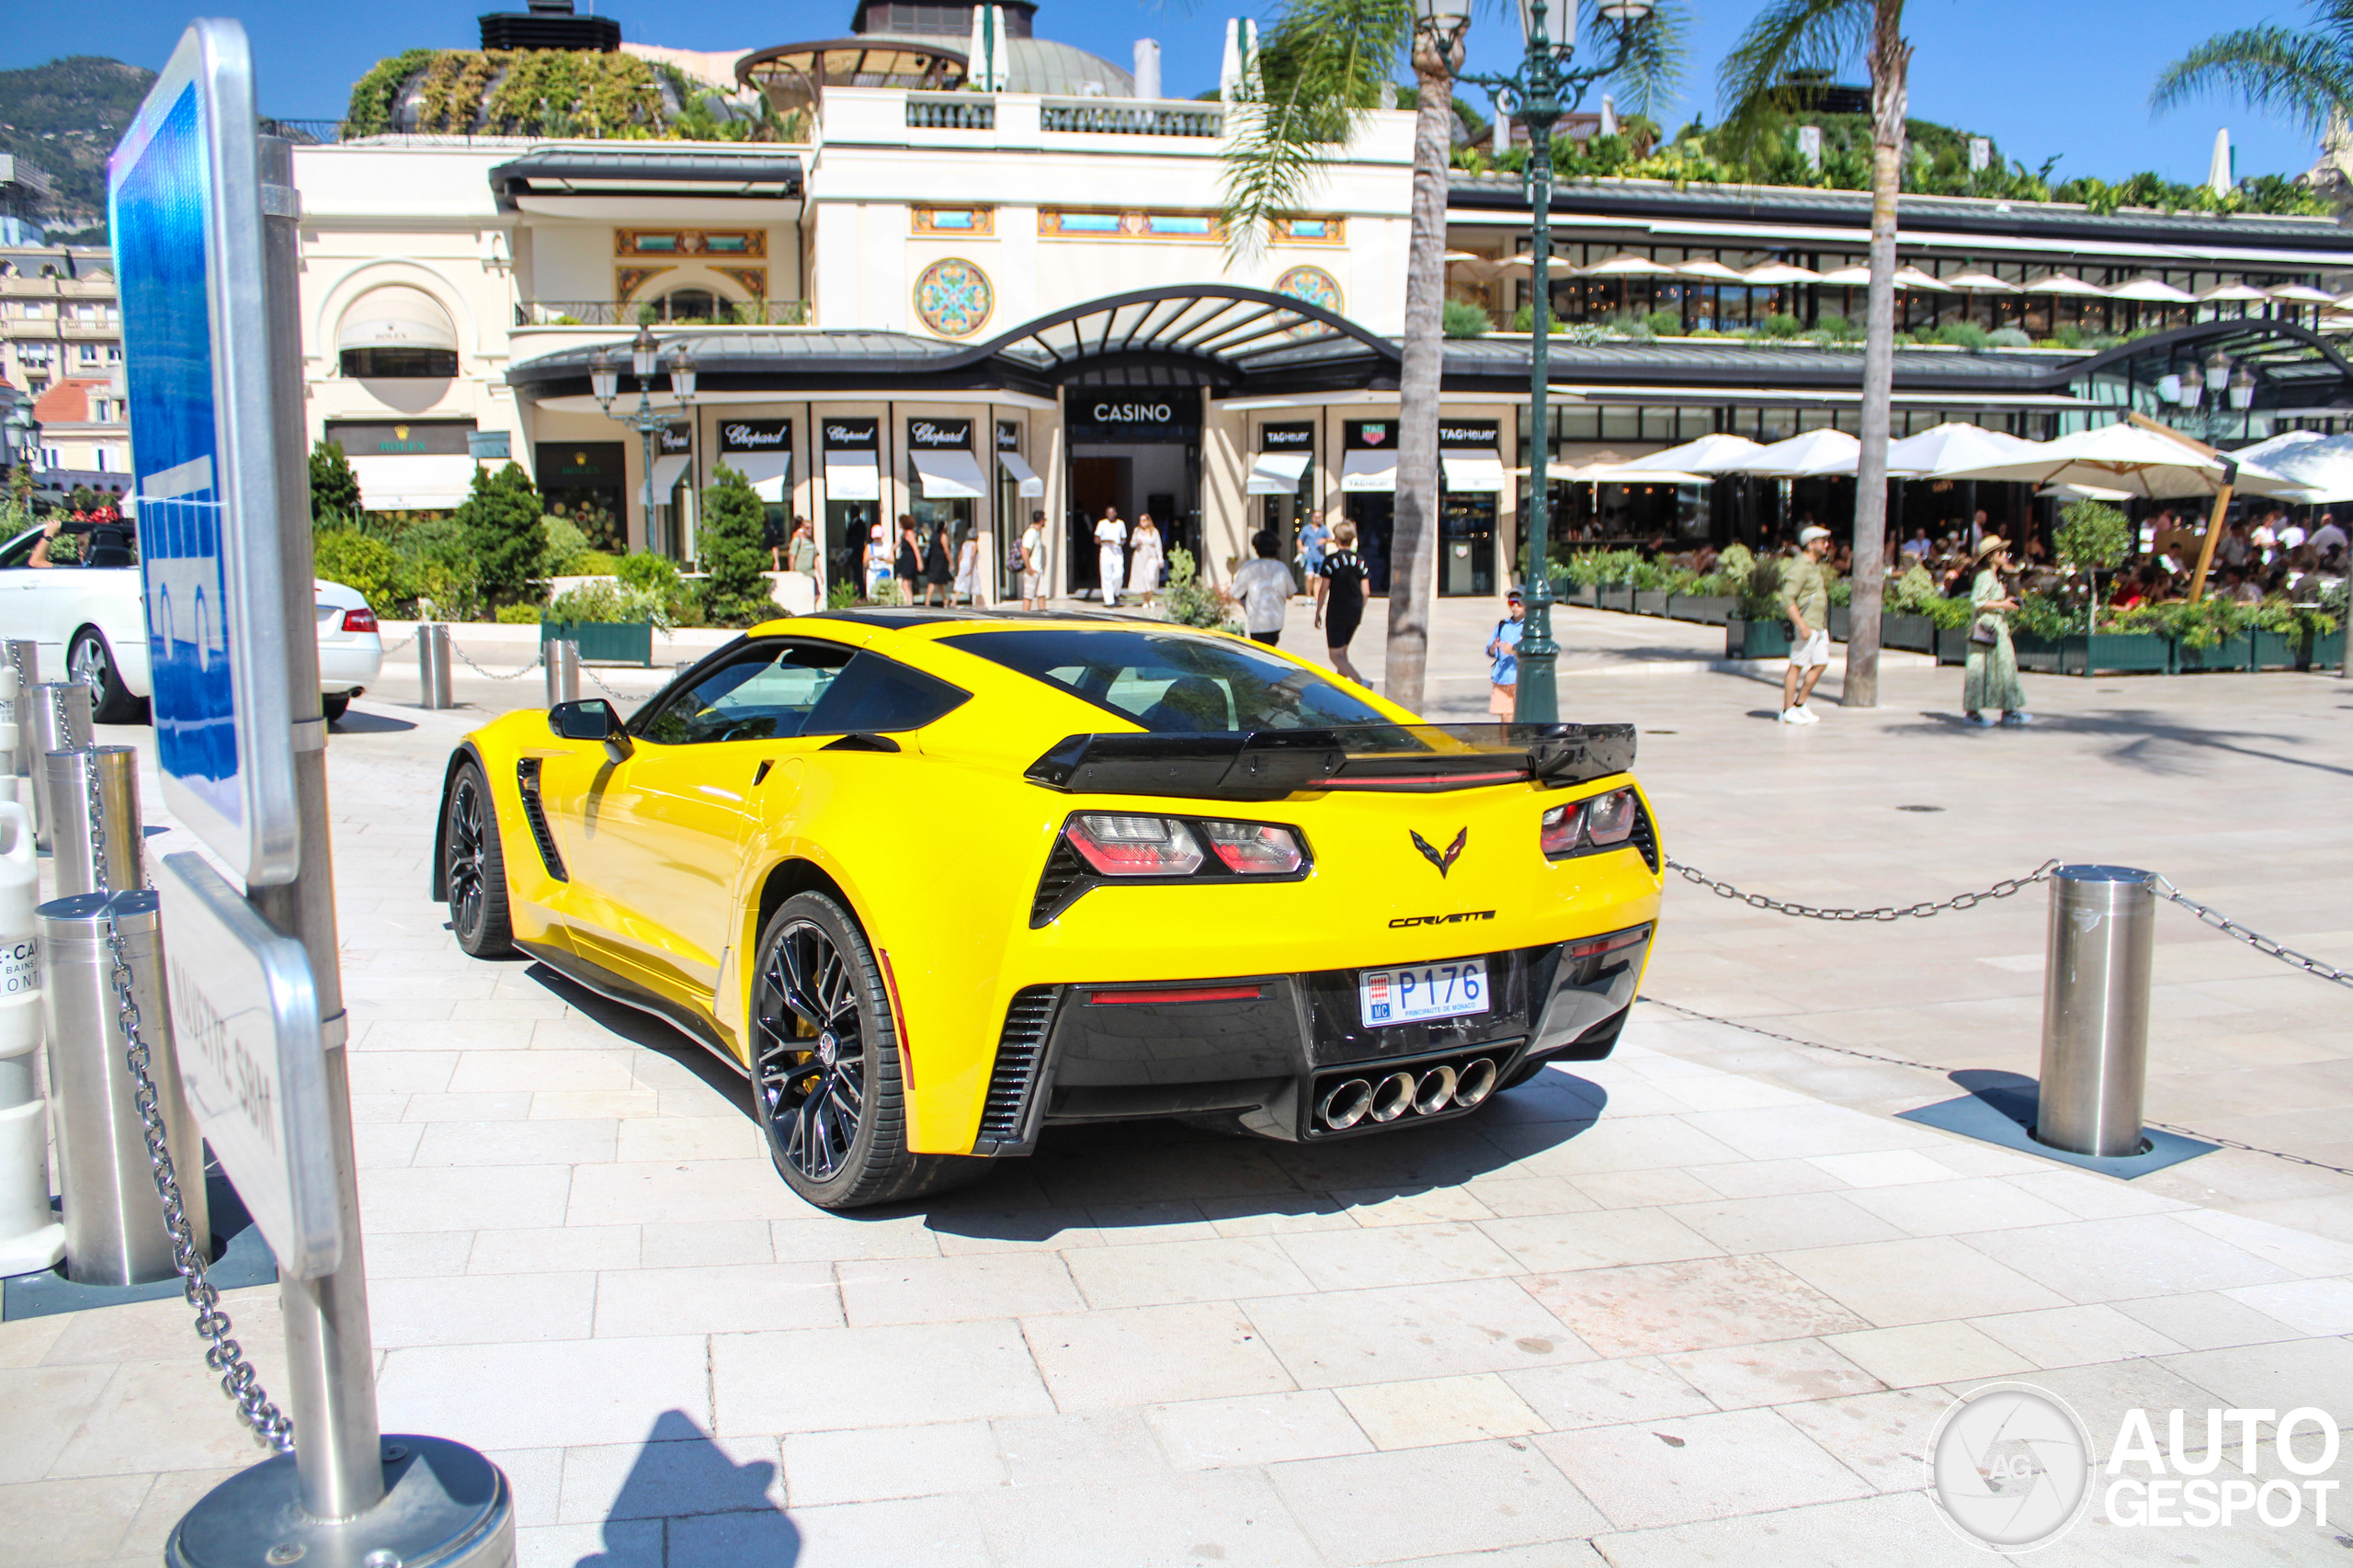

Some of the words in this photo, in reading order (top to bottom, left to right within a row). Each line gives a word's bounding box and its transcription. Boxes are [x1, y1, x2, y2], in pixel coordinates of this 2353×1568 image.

[375, 333, 407, 341] ROLEX
[1094, 403, 1172, 423] CASINO
[725, 424, 788, 449] Chopard
[827, 426, 874, 444] Chopard
[912, 422, 968, 447] Chopard
[380, 442, 426, 451] ROLEX
[562, 466, 600, 474] ROLEX
[1389, 910, 1496, 928] CORVETTE
[6, 960, 34, 974] BAINS
[1374, 1005, 1388, 1017] MC
[1405, 1006, 1441, 1017] PRINCIPAUTE
[1452, 1002, 1475, 1011] MONACO
